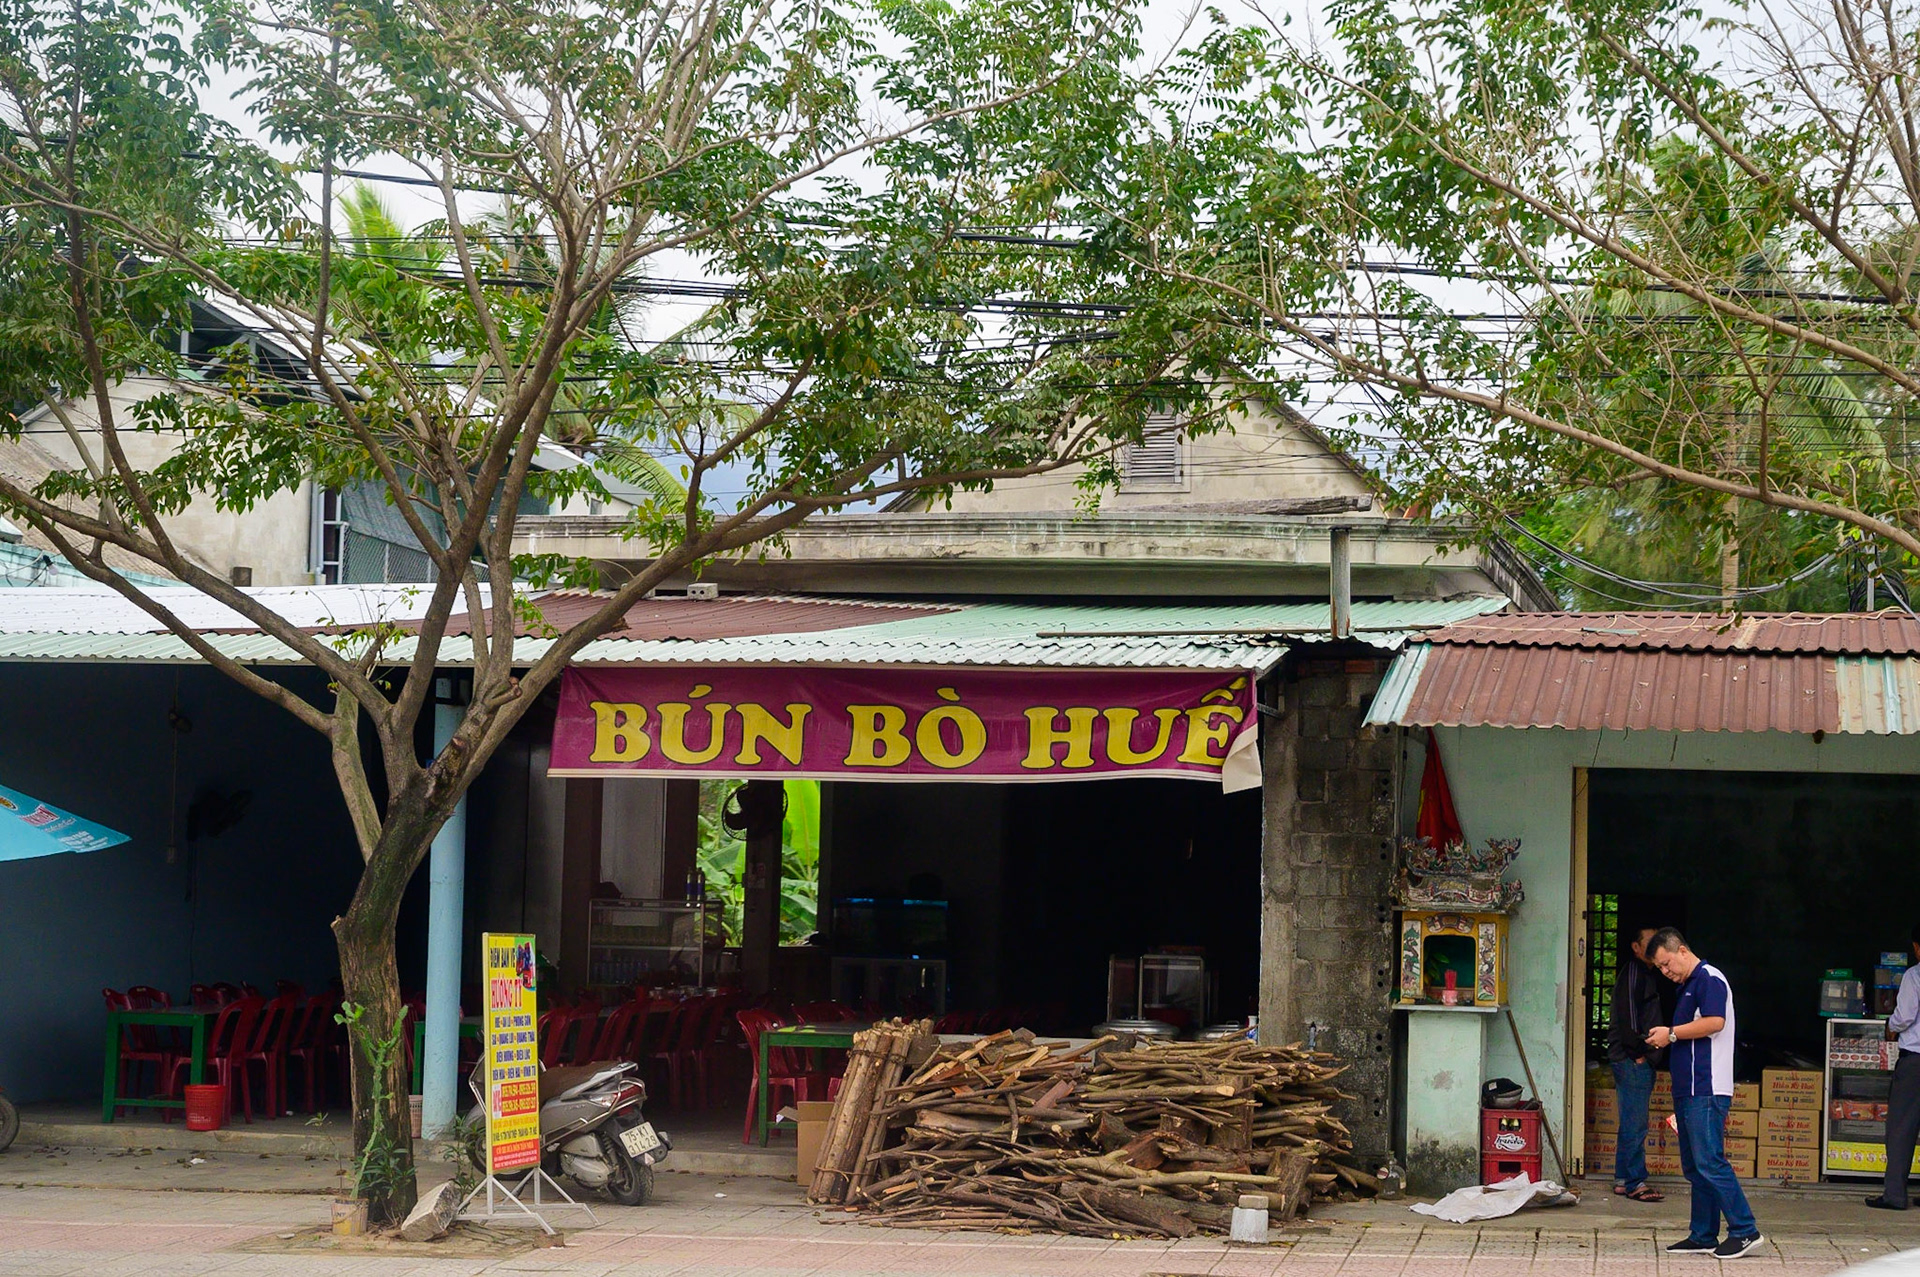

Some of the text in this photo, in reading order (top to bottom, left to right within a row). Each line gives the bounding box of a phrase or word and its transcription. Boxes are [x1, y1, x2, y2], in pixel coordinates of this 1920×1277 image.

[589, 676, 1249, 769] BÚN BÒ HUẾ
[625, 1126, 649, 1143] 75-K1
